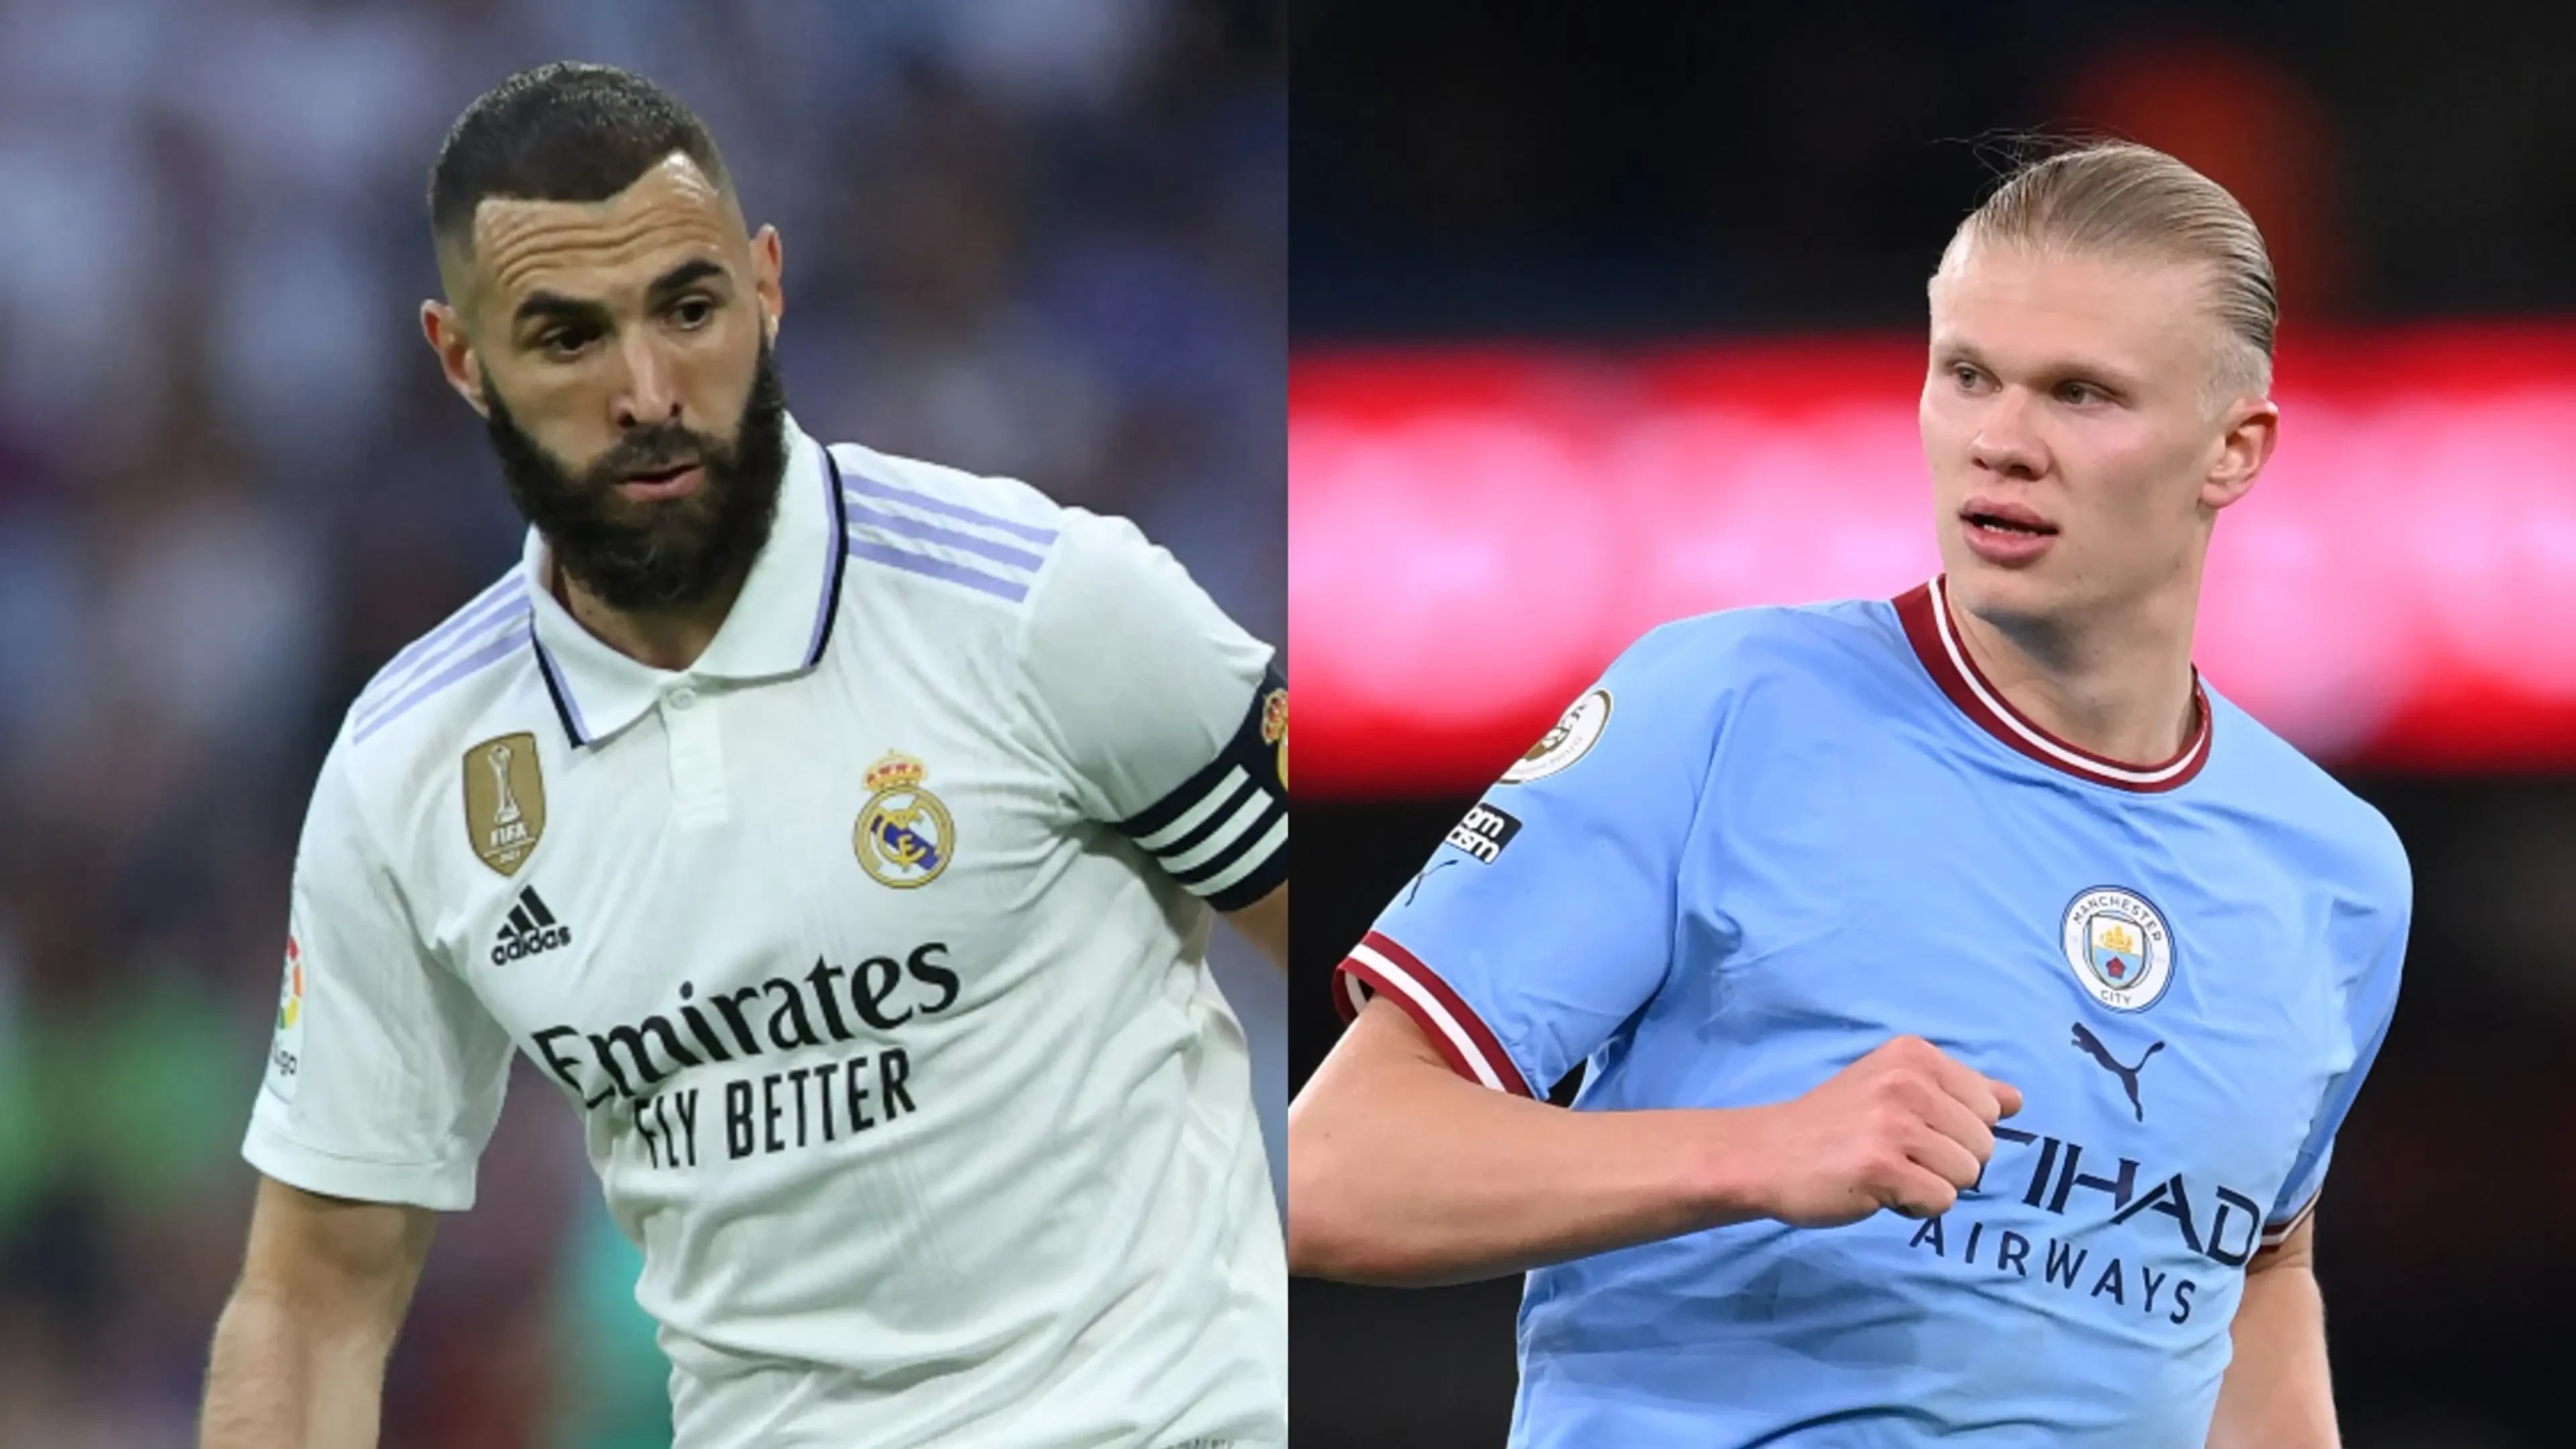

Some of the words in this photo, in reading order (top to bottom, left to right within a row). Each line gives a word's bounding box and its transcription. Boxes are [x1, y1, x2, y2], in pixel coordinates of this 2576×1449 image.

[490, 822, 528, 847] FIFA
[1461, 806, 1505, 838] om
[2072, 896, 2162, 941] MANCHESTER
[491, 926, 572, 966] adidas
[2100, 989, 2132, 1006] CITY
[531, 942, 961, 1110] Emirates
[634, 1088, 698, 1169] FLY
[726, 1047, 916, 1161] BETTER
[1909, 1215, 2196, 1325] AIRWAYS
